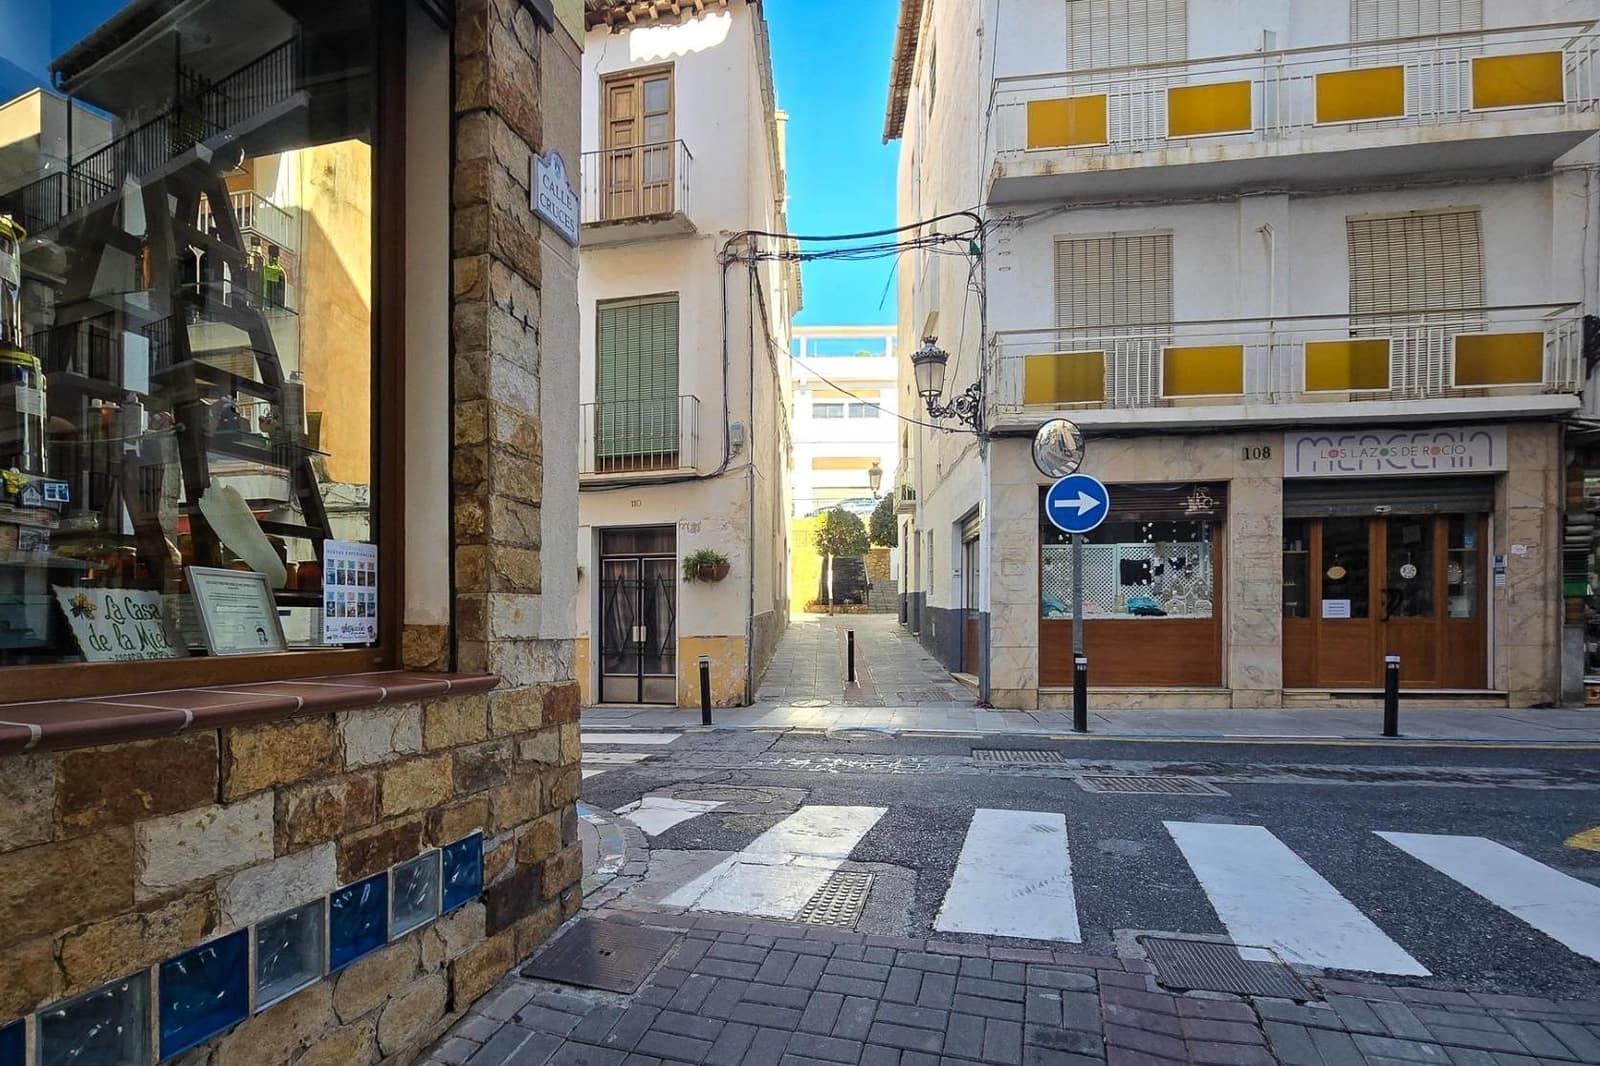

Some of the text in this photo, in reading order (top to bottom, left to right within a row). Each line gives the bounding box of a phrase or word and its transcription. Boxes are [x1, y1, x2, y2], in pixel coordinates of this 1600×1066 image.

[543, 174, 572, 210] CALLE
[540, 193, 575, 232] CRUCES
[1243, 446, 1271, 460] 108
[1320, 448, 1347, 459] LOS
[1351, 449, 1398, 458] LAZOS
[1401, 446, 1417, 456] DE
[105, 595, 160, 625] La Casa
[89, 622, 173, 651] de la Miel
